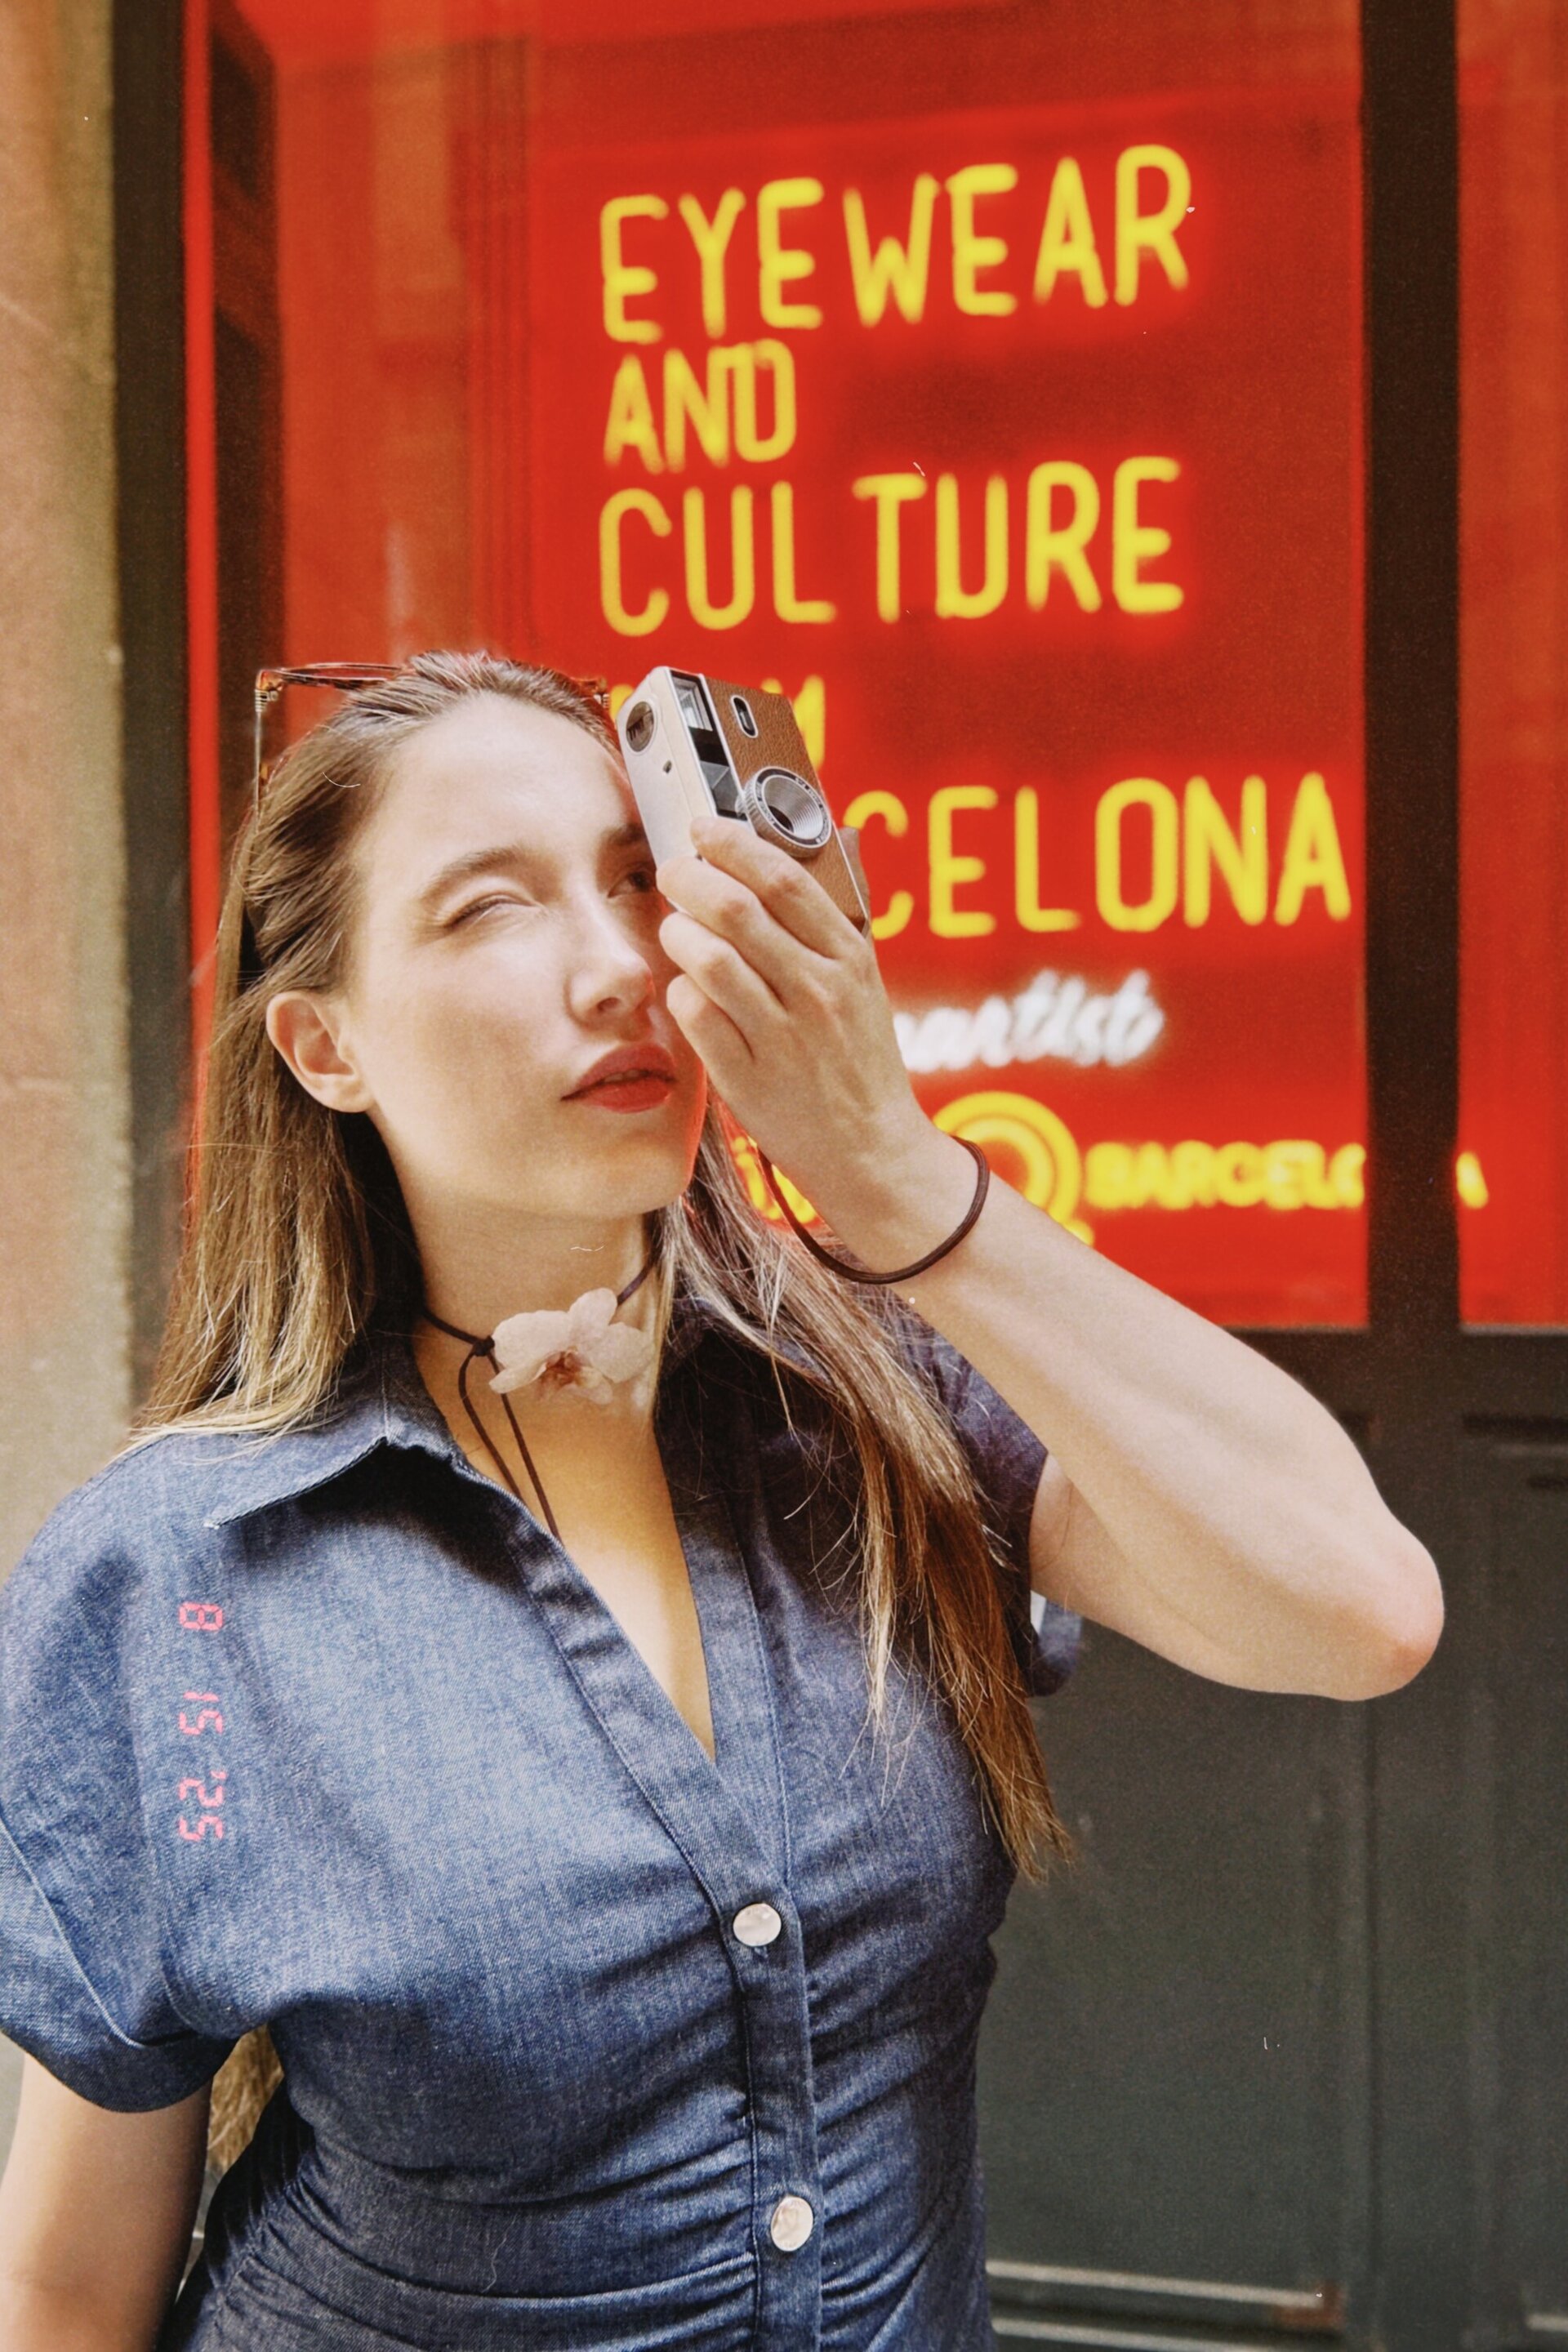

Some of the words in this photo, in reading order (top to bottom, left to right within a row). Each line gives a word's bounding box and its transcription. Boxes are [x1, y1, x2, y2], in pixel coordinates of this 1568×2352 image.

[599, 144, 1192, 345] EYEWEAR
[604, 338, 797, 474] AND
[599, 455, 1184, 637] CULTURE
[843, 771, 1352, 940] CELONA
